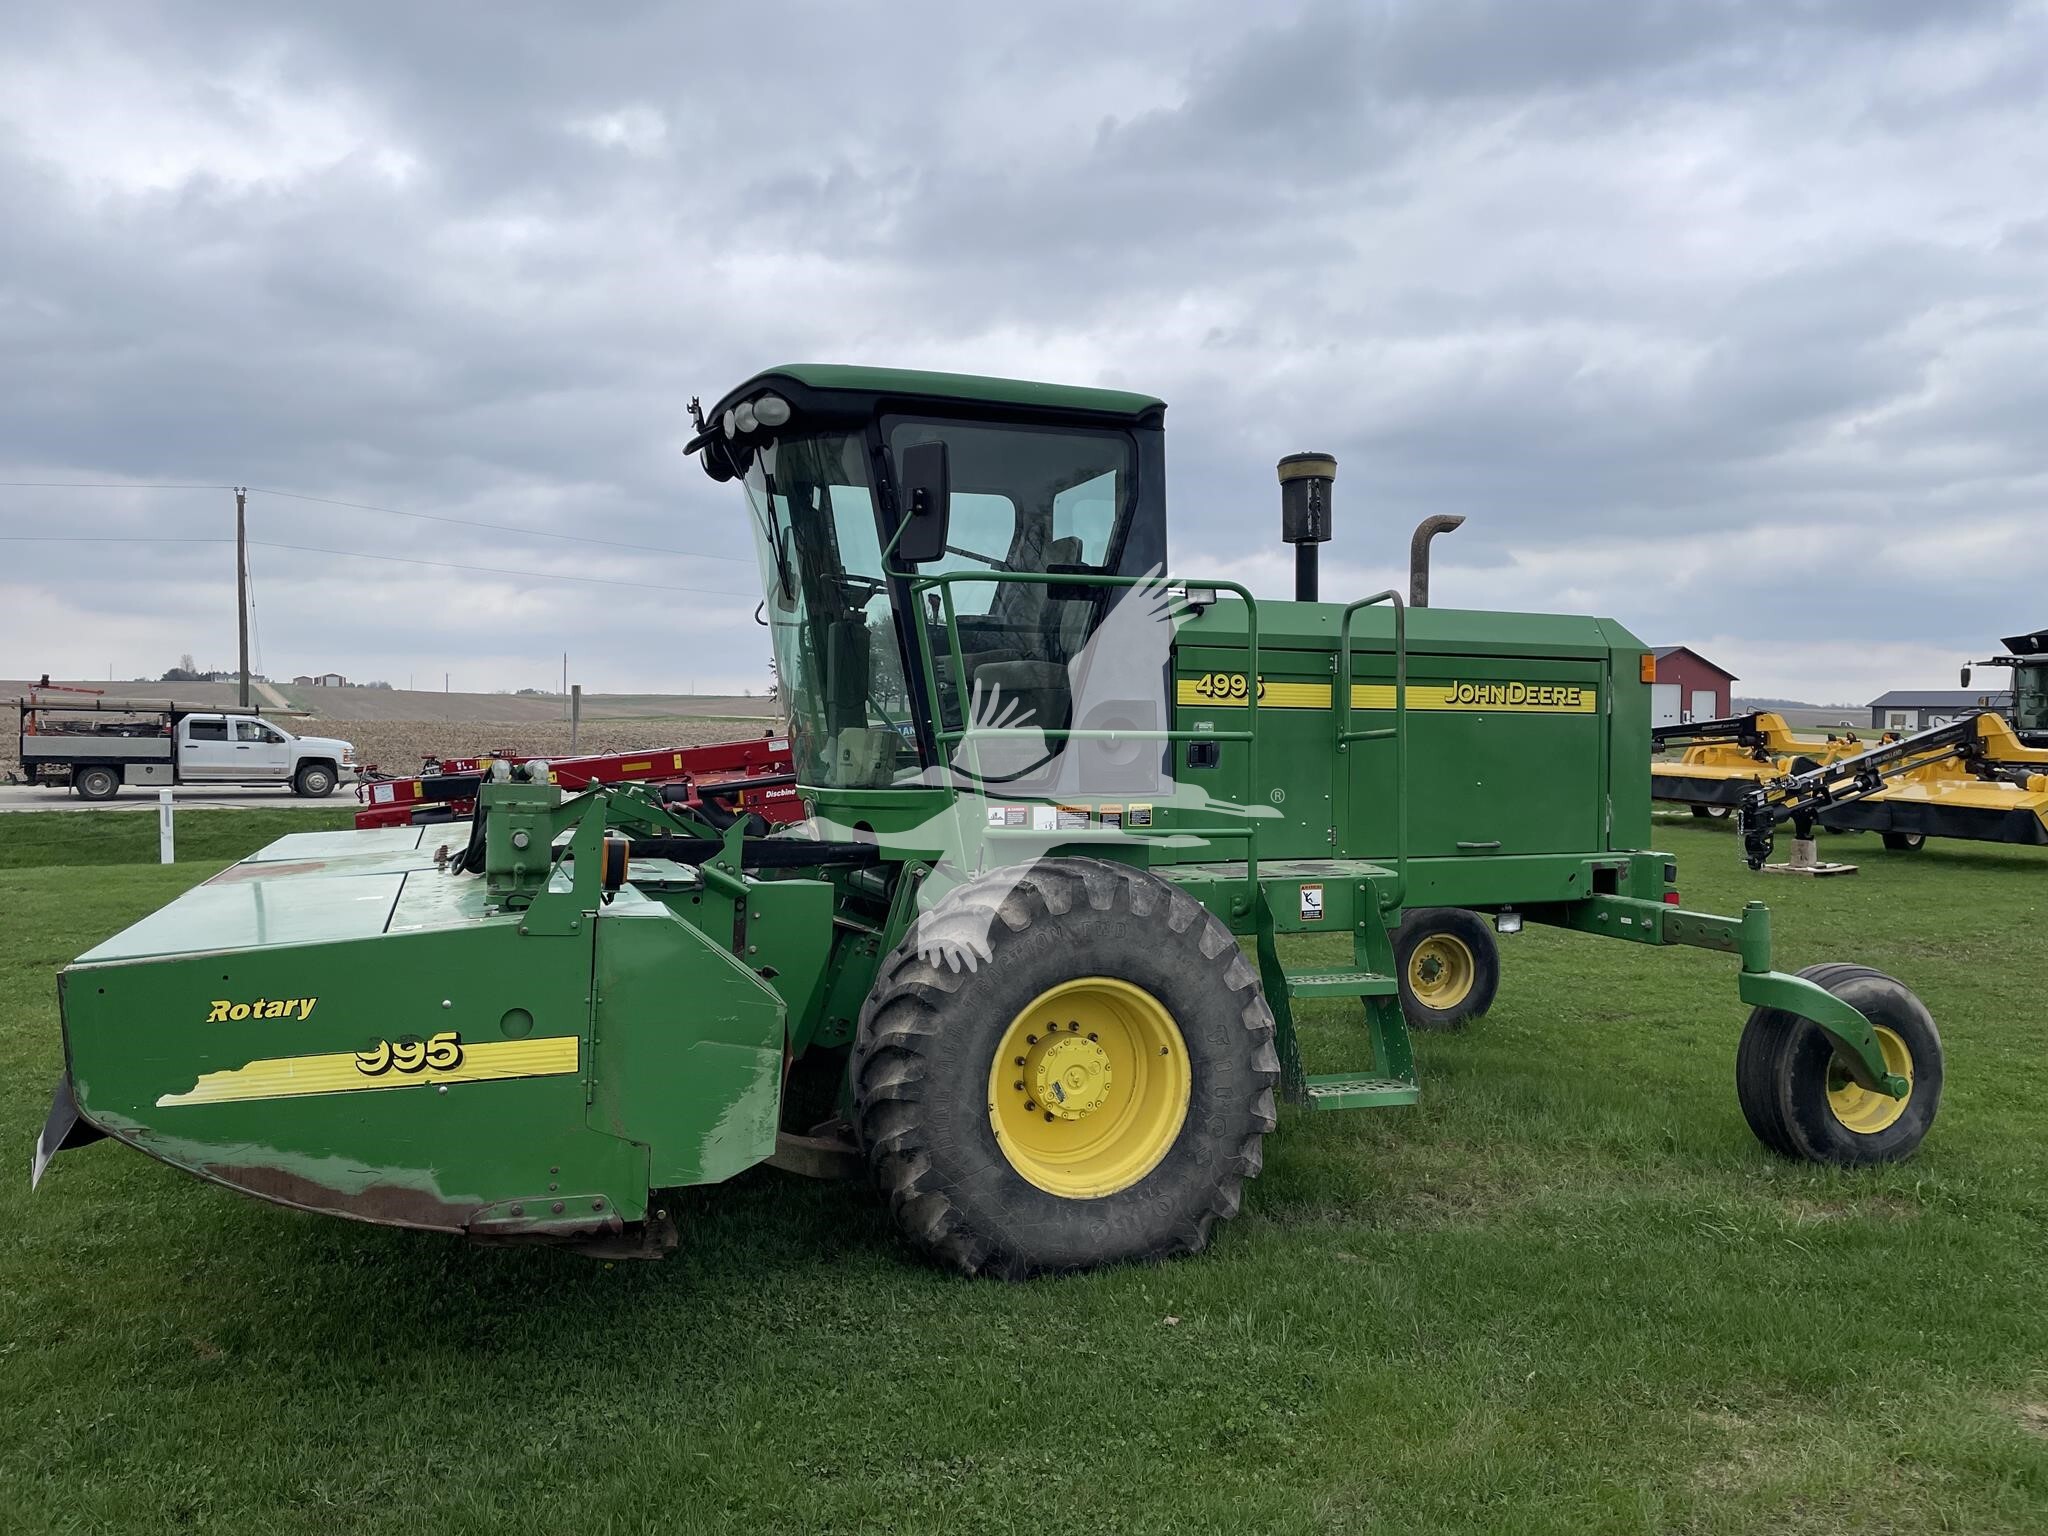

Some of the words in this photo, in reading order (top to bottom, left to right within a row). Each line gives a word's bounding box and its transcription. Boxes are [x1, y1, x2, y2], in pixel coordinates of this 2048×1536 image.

[1444, 680, 1506, 704] JOHN
[1507, 681, 1581, 706] DEERE
[1081, 920, 1129, 939] FWD
[206, 997, 319, 1023] Rotary
[355, 1031, 464, 1077] 995
